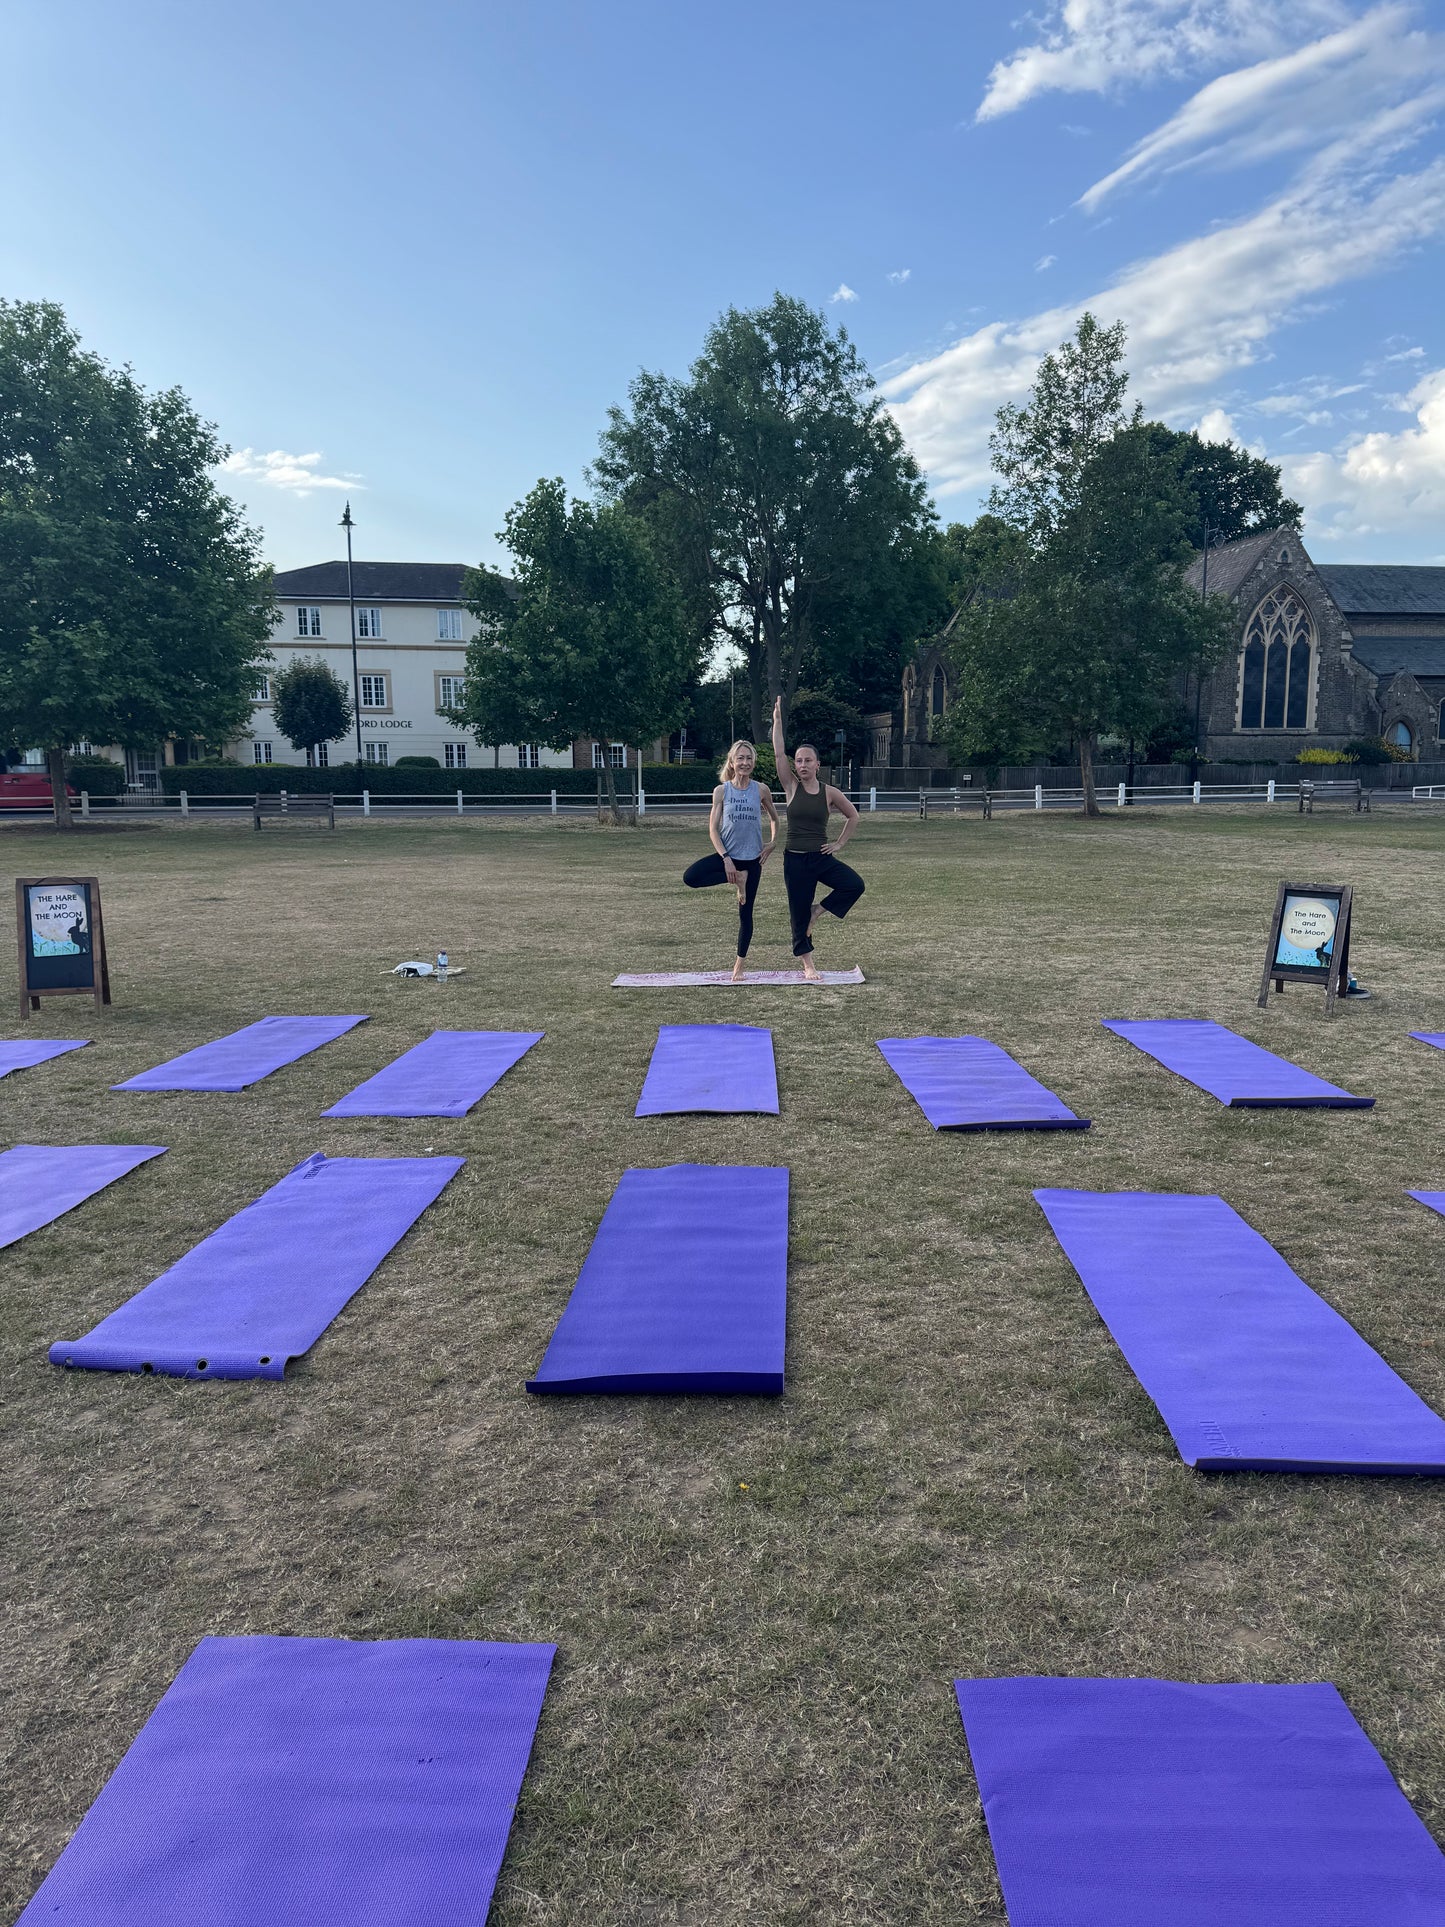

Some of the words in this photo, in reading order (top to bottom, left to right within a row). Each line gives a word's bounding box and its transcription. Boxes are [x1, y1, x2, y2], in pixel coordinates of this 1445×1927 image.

[380, 720, 413, 728] LODGE
[37, 895, 53, 903] THE
[55, 894, 77, 902] HARE
[49, 903, 68, 911] AND
[53, 911, 82, 919] MOON
